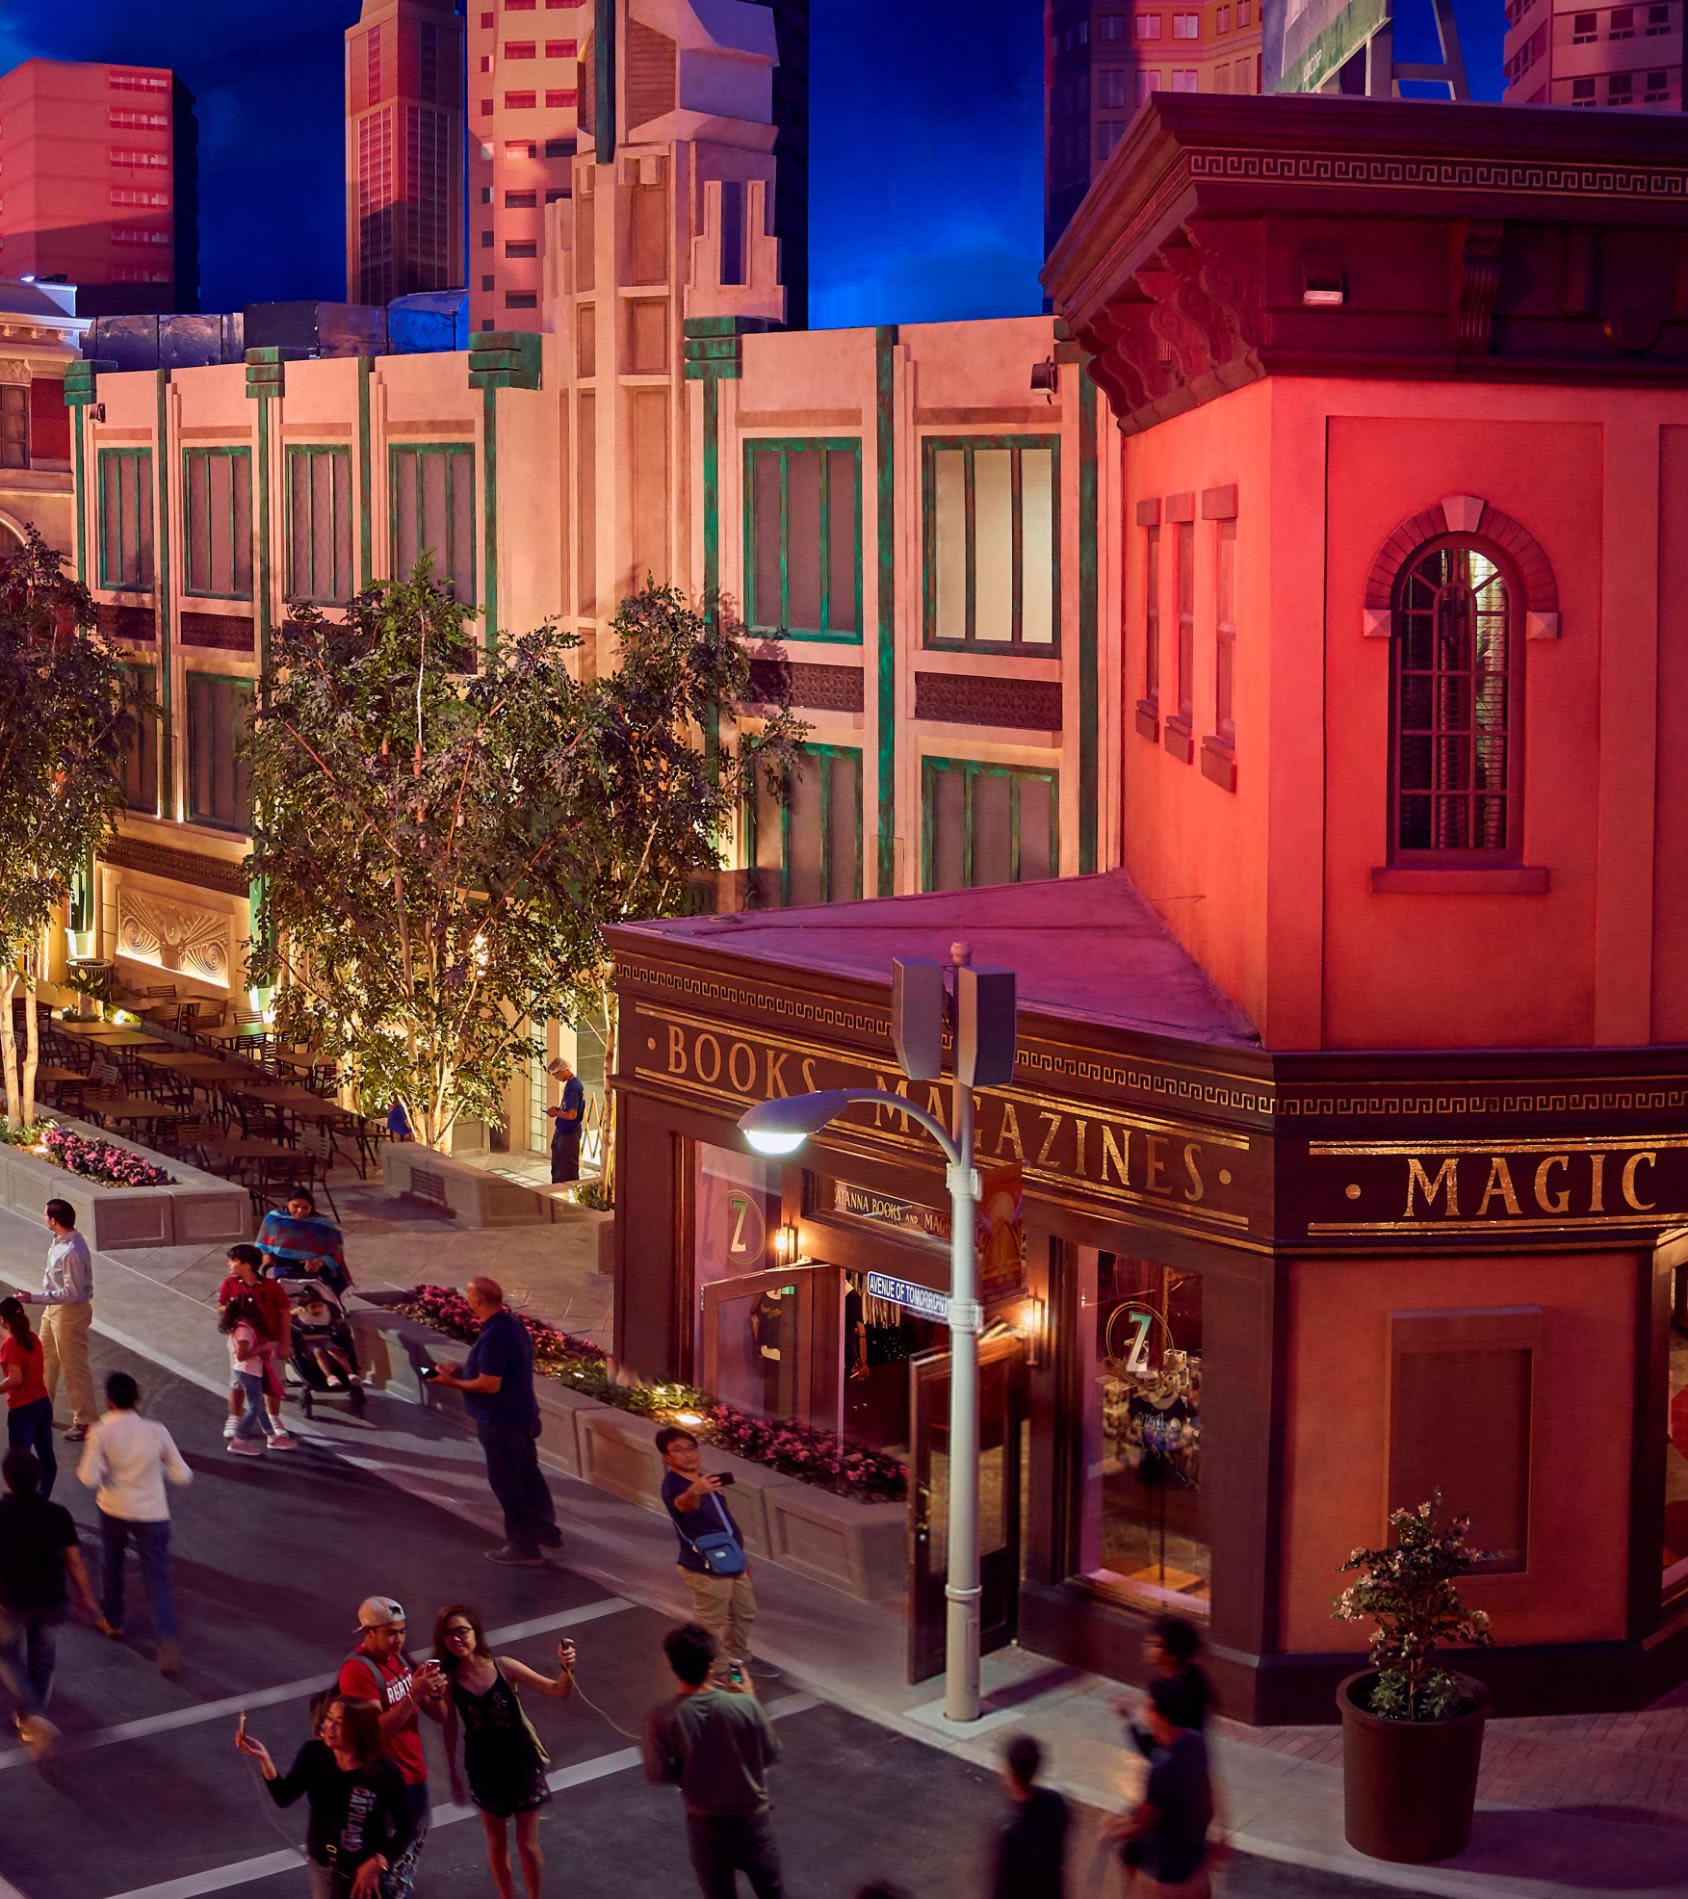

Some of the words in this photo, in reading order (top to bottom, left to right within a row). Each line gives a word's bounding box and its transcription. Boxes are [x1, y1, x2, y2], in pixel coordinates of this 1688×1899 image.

[667, 1024, 816, 1099] BOOKS
[873, 1075, 1203, 1201] MAAZINES
[871, 1198, 901, 1221] BOOKS
[1402, 1152, 1657, 1217] MAGIC
[730, 1199, 748, 1252] Z
[869, 1275, 895, 1298] AVENUE
[895, 1282, 905, 1300] OF
[906, 1285, 947, 1312] TOMORROW
[1126, 1311, 1152, 1372] Z
